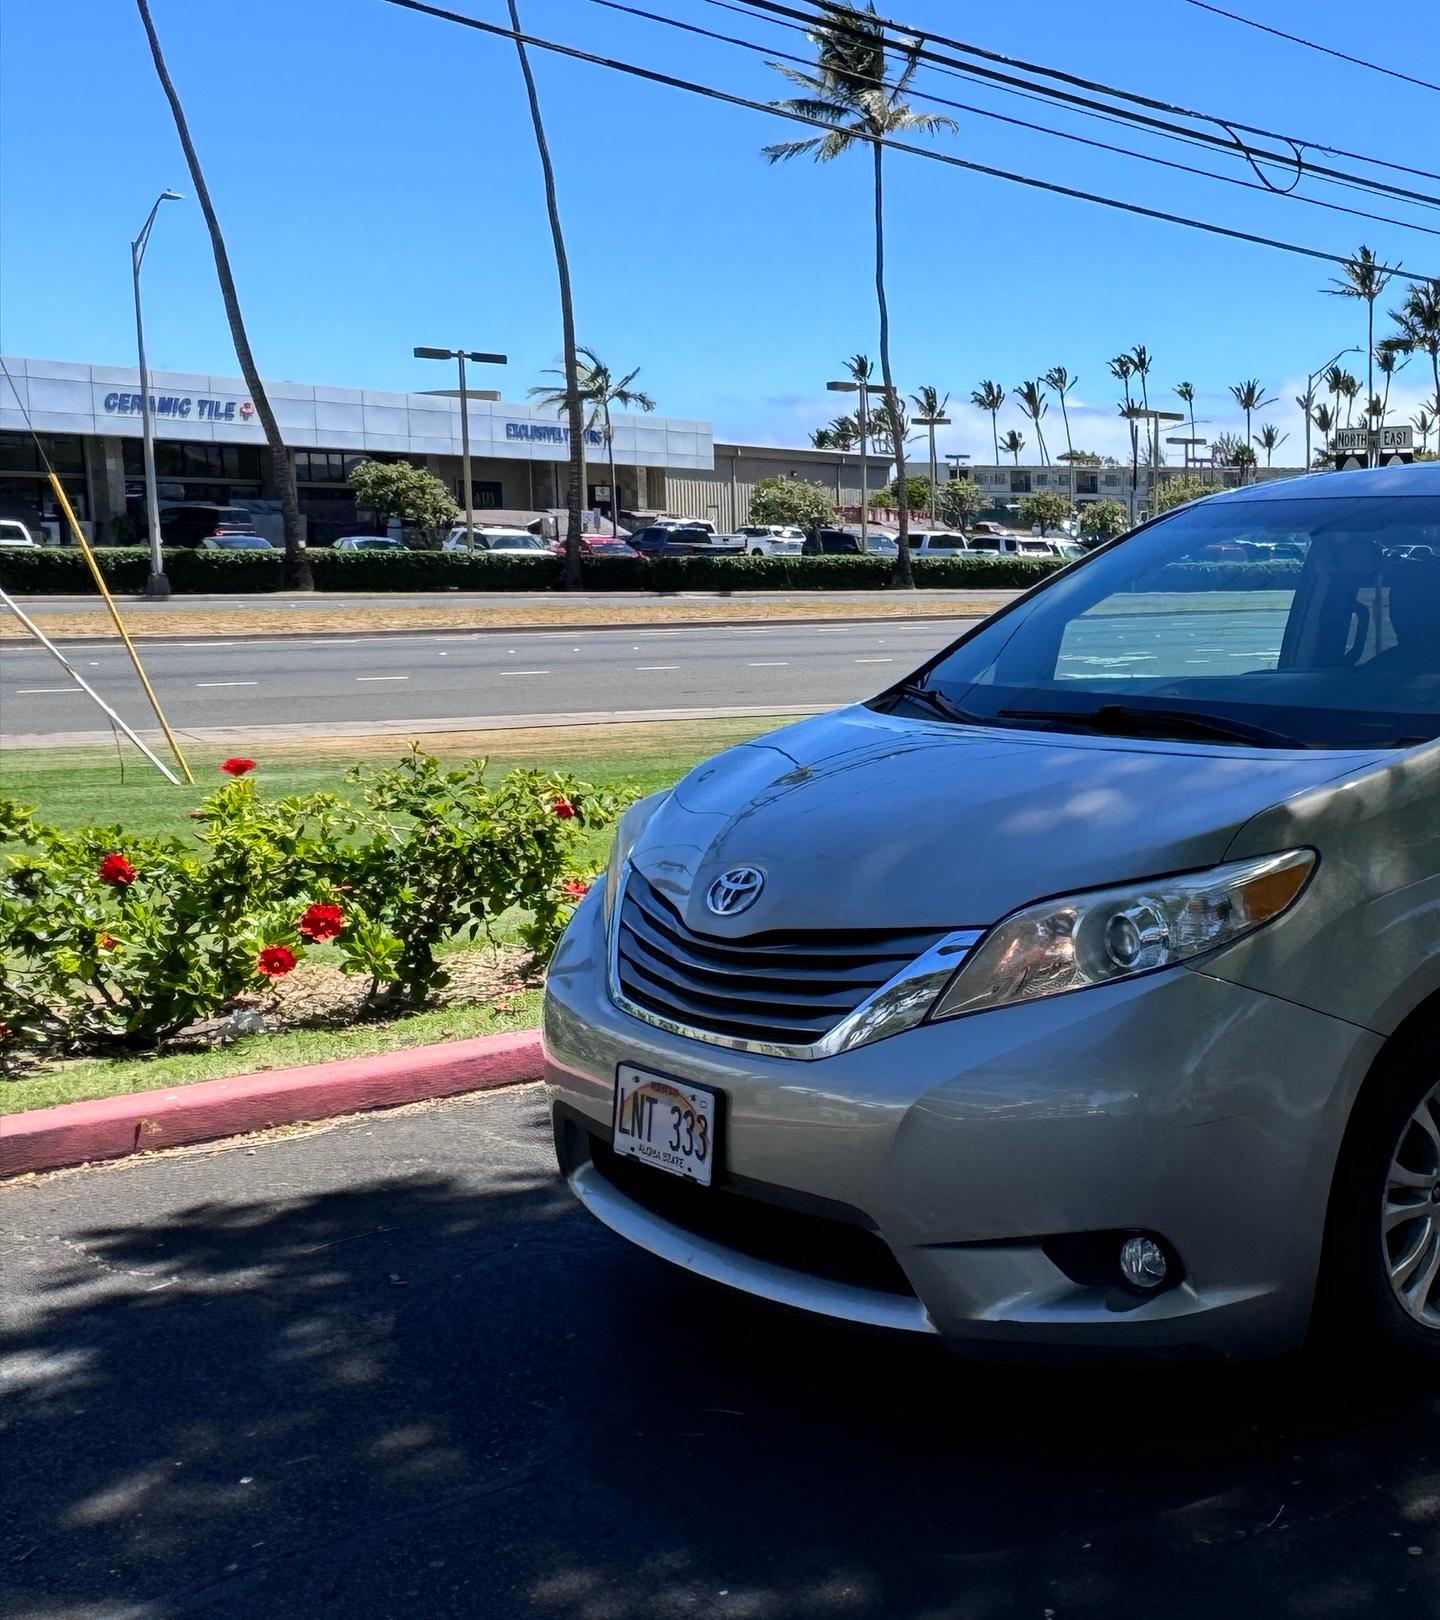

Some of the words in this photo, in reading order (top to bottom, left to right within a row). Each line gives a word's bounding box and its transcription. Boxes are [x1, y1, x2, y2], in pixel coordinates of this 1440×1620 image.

[104, 392, 191, 418] CERAMIC
[197, 399, 237, 421] TILE
[1338, 431, 1367, 447] NORTH
[1384, 430, 1407, 446] EAST
[618, 1087, 658, 1142] LNT
[669, 1105, 708, 1162] 333
